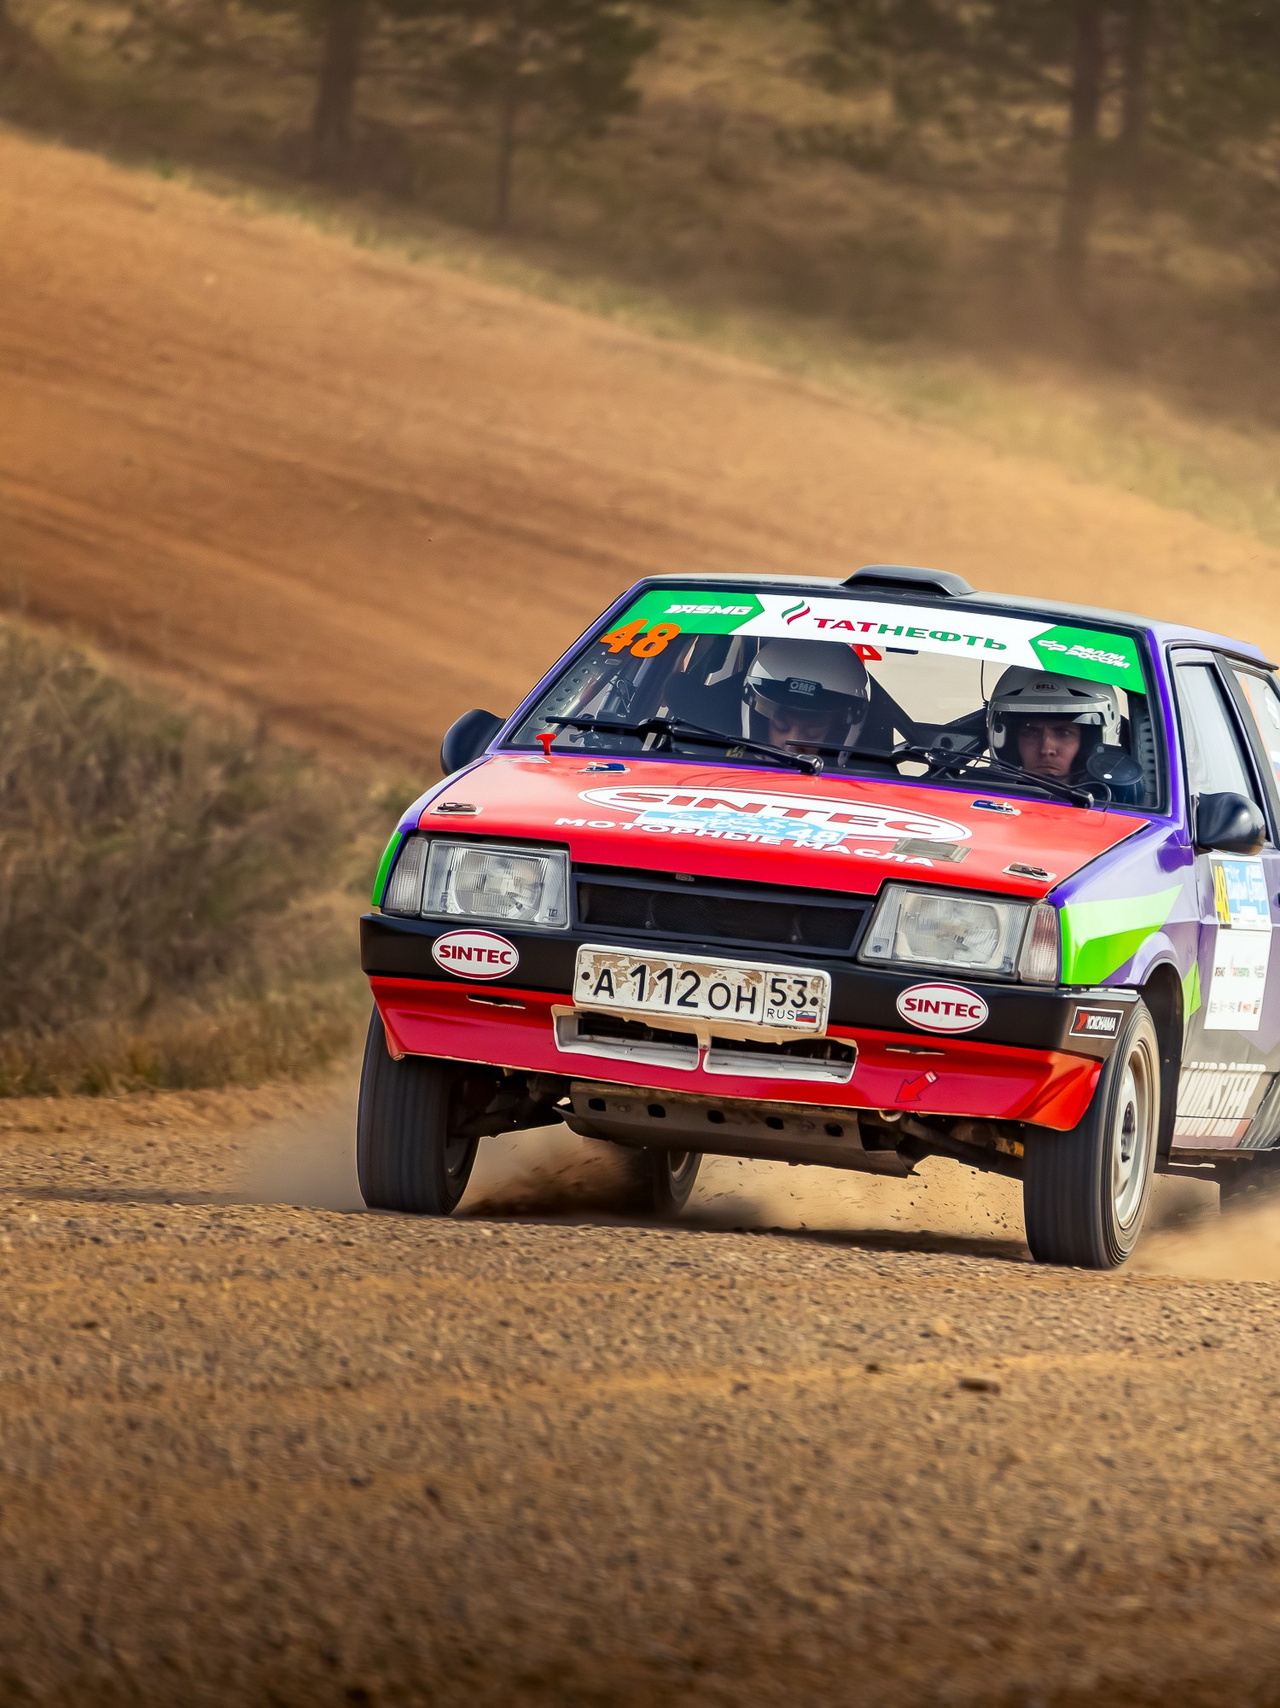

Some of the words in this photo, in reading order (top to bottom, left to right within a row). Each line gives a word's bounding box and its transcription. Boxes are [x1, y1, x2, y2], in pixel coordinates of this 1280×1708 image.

[600, 618, 681, 658] 48
[813, 617, 1007, 651] ТАТНЕФТЬ
[789, 681, 816, 693] OMP
[608, 791, 942, 835] SINTEC
[553, 817, 783, 846] МОТОРНЫЕ
[793, 839, 935, 868] МАСЛА
[786, 828, 841, 843] 48
[438, 943, 513, 966] SINTEC
[769, 978, 808, 1009] 53
[766, 1007, 795, 1020] RUS
[903, 997, 982, 1020] SINTEC
